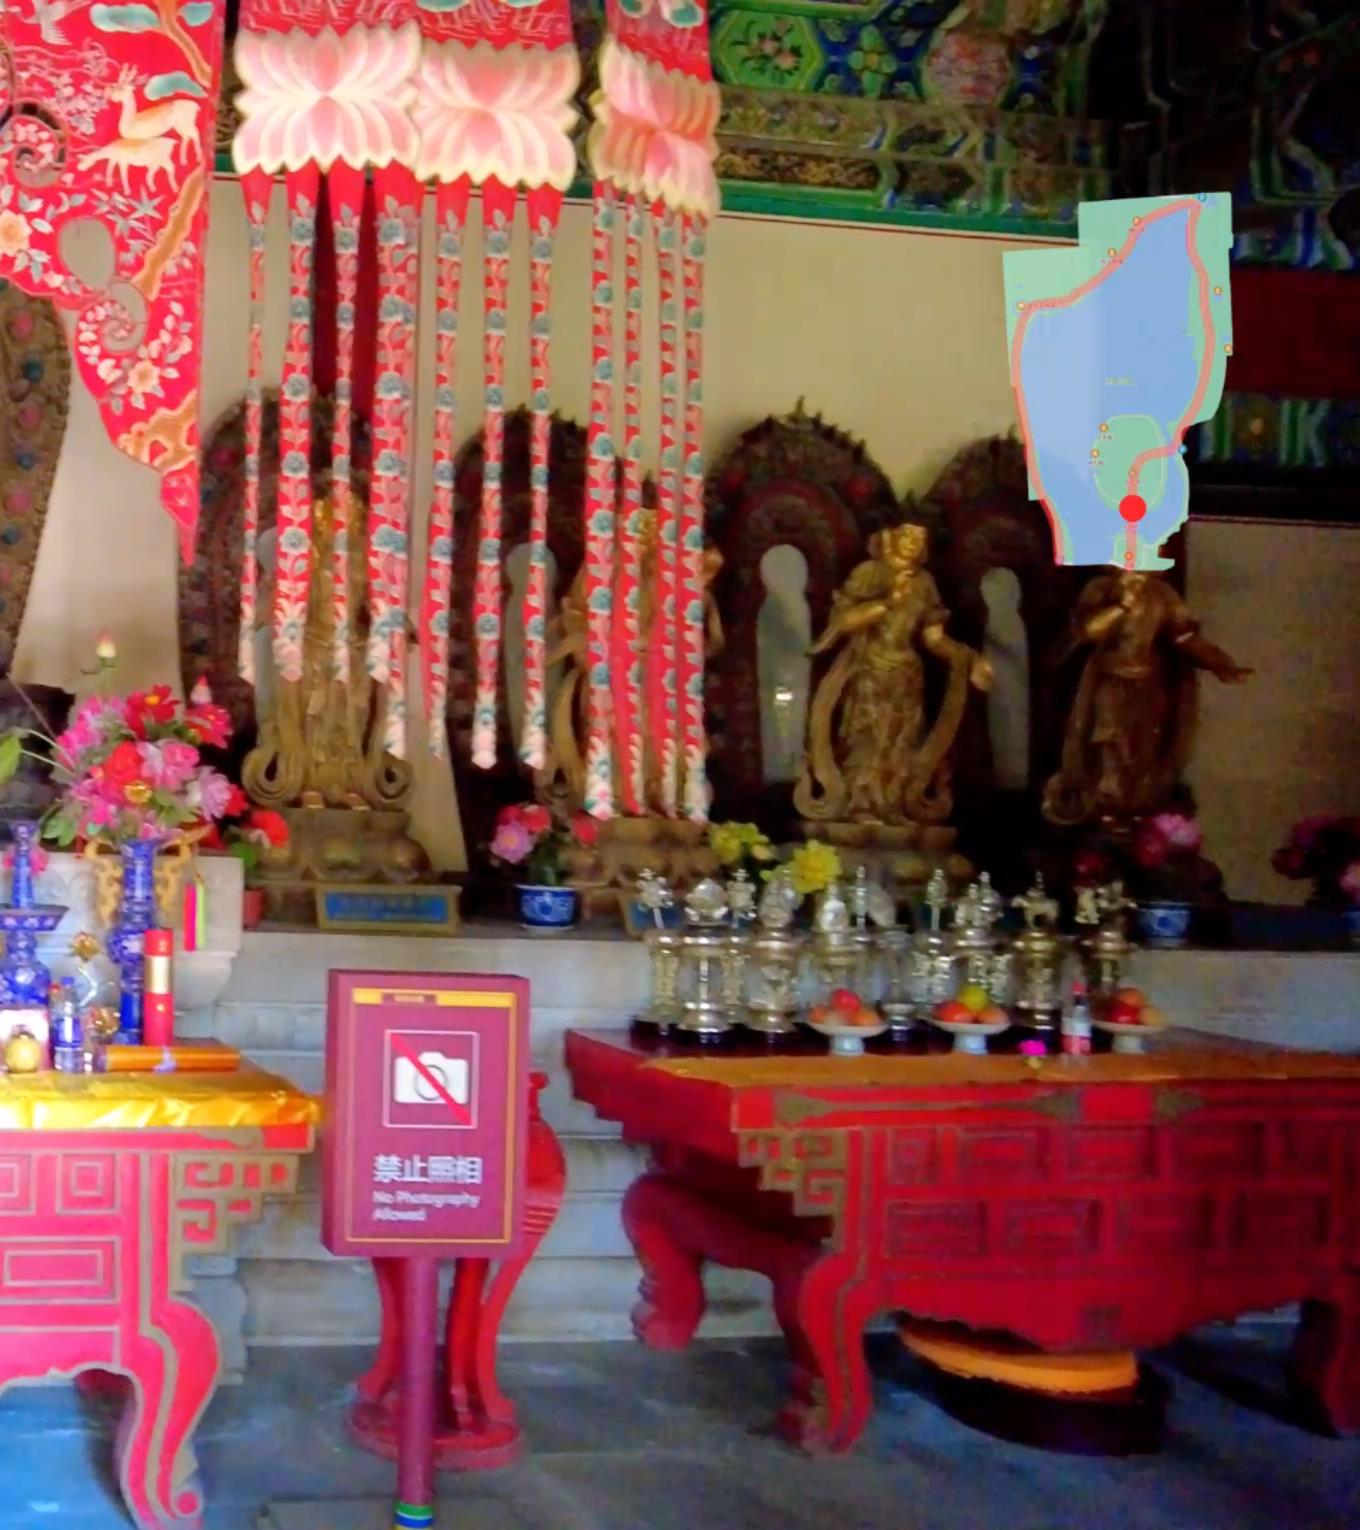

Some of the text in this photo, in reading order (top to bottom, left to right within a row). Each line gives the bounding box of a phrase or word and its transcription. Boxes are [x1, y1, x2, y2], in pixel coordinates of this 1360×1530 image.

[373, 1154, 482, 1184] 禁止照相
[373, 1190, 480, 1208] No Photography
[372, 1207, 426, 1221] Allowed
